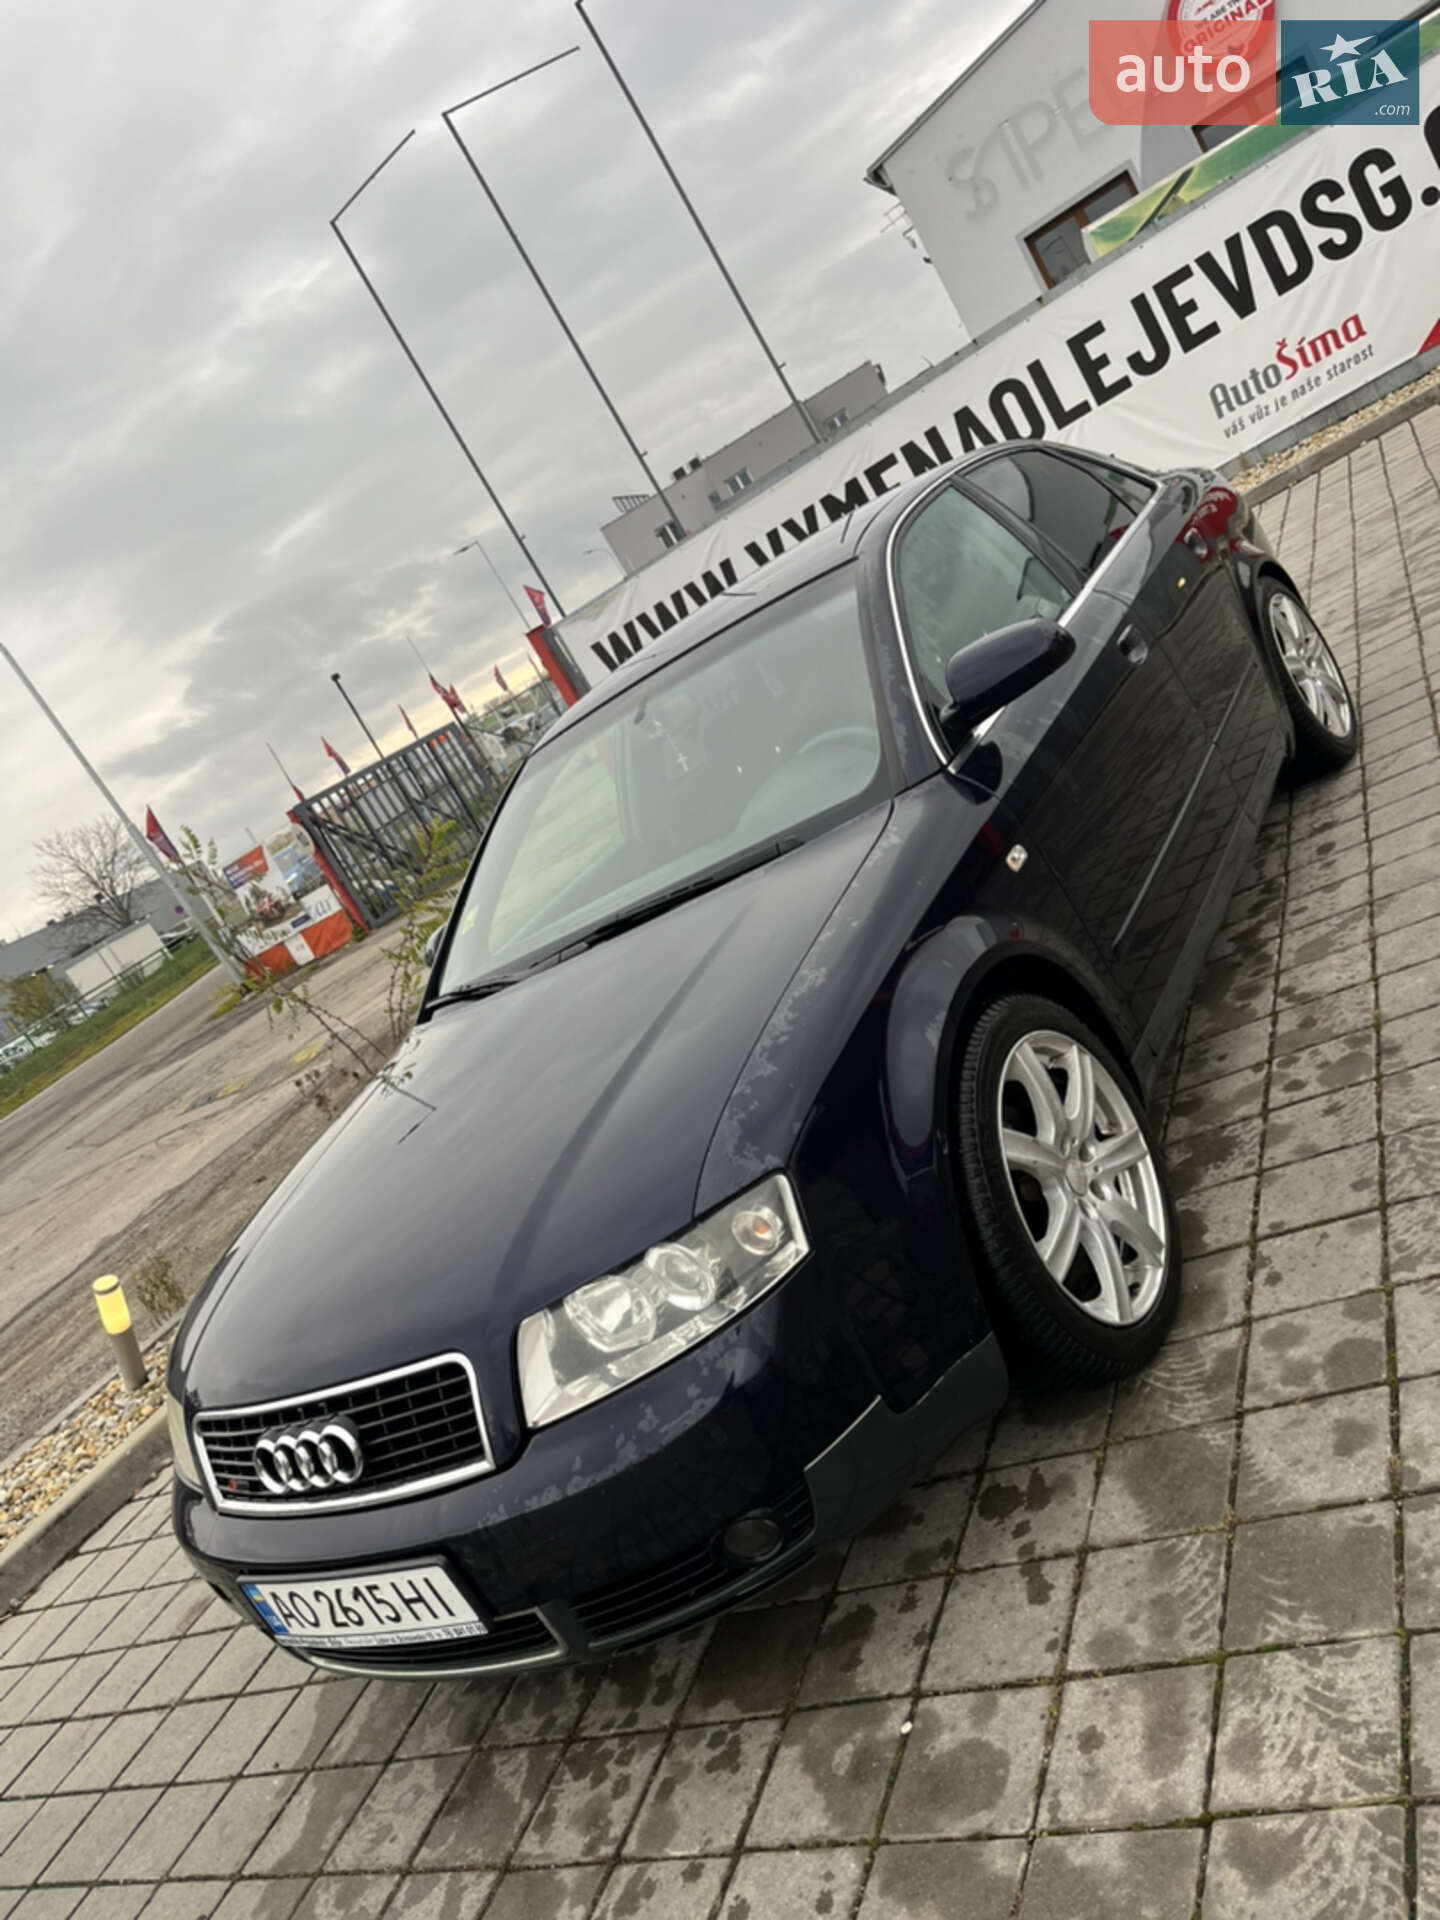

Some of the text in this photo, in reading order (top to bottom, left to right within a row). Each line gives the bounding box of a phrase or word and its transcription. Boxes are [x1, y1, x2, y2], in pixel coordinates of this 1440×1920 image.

[1209, 313, 1367, 419] AutoŠíma
[1273, 395, 1288, 412] je
[1291, 374, 1322, 401] naše
[1325, 343, 1374, 381] starost
